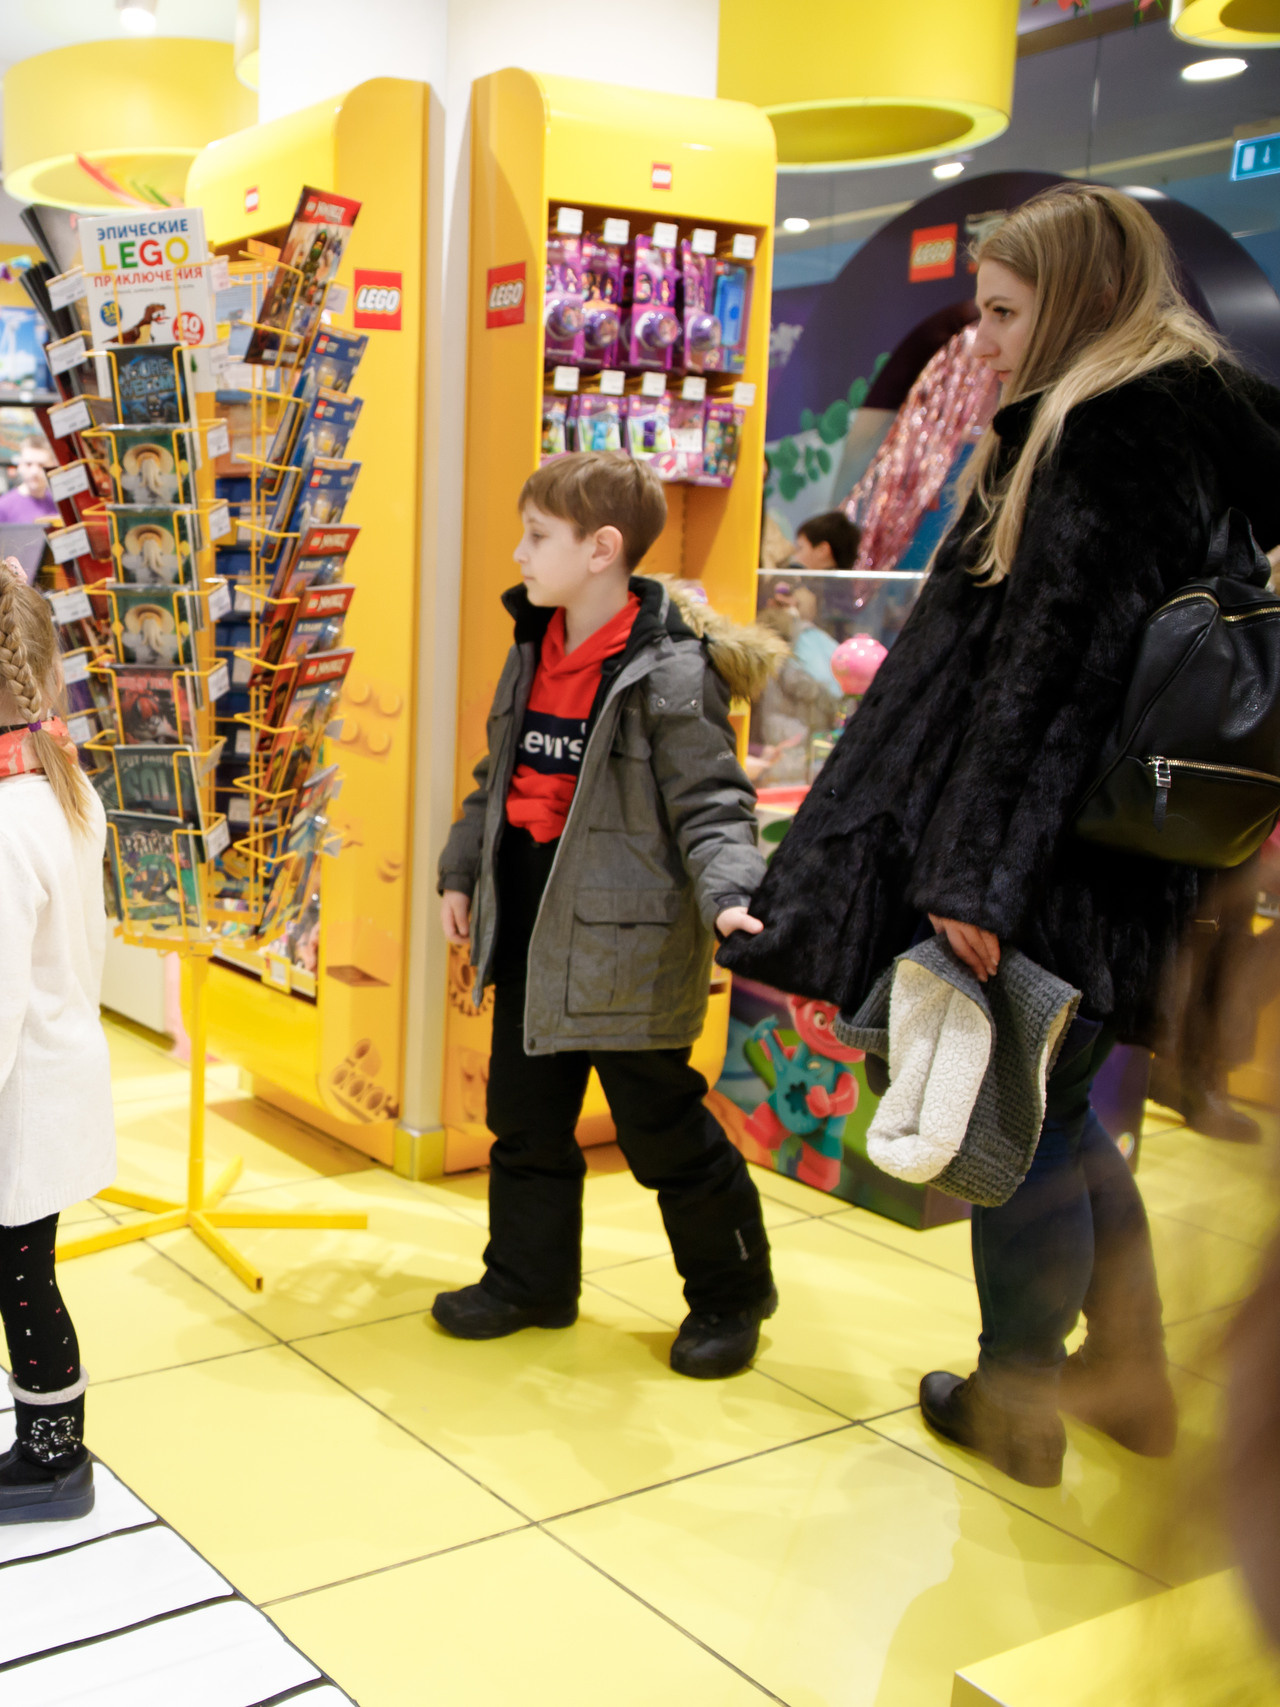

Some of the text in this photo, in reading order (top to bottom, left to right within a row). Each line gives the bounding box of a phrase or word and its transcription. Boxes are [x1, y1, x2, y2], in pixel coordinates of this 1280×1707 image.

[97, 219, 188, 241] ЭПИЧЕСКИЕ
[99, 236, 190, 271] LEGO
[357, 287, 400, 314] LEGO
[489, 281, 523, 309] LEGO
[520, 730, 584, 762] evi's
